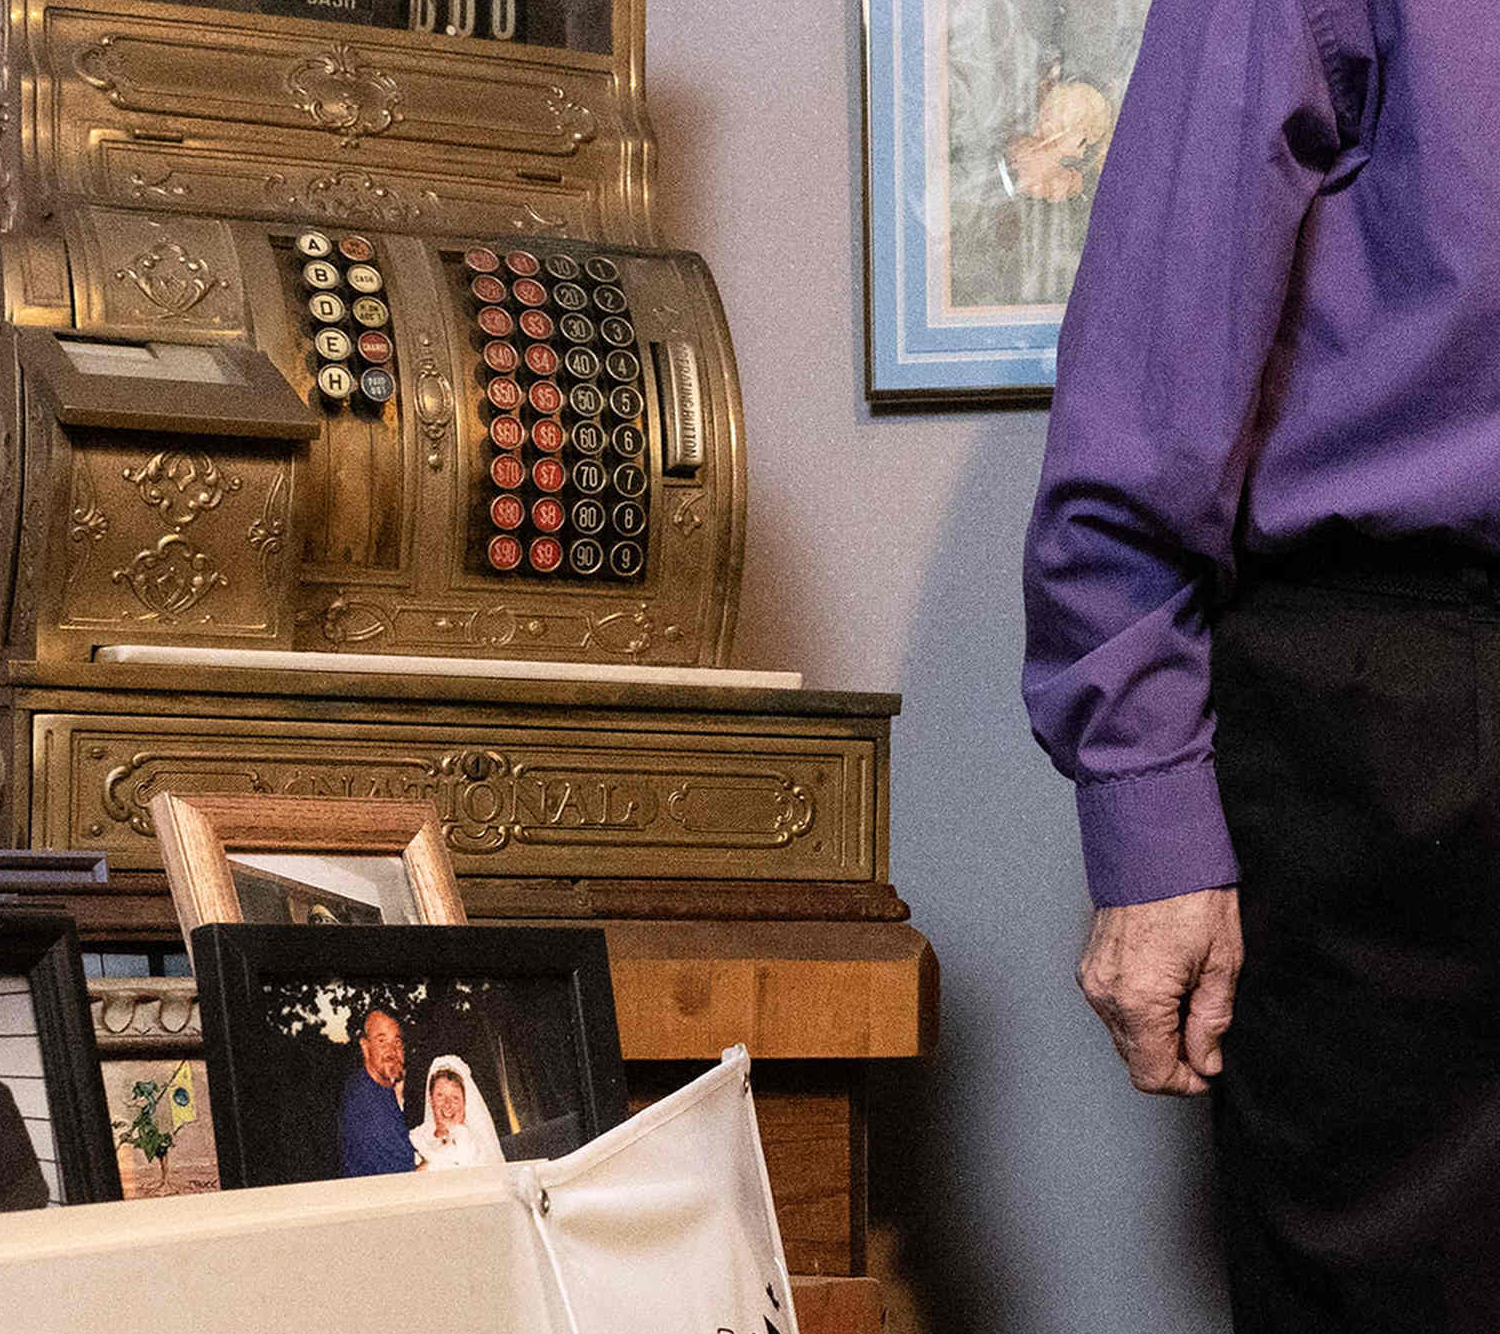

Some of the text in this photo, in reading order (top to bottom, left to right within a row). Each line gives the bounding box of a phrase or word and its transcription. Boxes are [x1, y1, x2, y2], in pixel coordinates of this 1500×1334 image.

[308, 238, 321, 251] A
[314, 268, 328, 282] B
[320, 301, 332, 315] D
[560, 289, 579, 306] 20
[604, 291, 614, 308] 2
[567, 319, 587, 338] 30
[611, 323, 623, 341] 3
[327, 336, 340, 353] E
[533, 350, 551, 370] $4
[572, 354, 590, 374] 40
[617, 358, 628, 376] 4
[329, 373, 342, 390] H
[493, 382, 516, 404] $50
[538, 388, 554, 409] $5
[577, 389, 595, 411] 50
[621, 392, 631, 413] 5
[540, 424, 557, 446] $6
[580, 427, 597, 448] 60
[624, 430, 634, 451] 6
[682, 409, 698, 459] BUTTON
[496, 460, 519, 482] $70
[540, 464, 556, 486] $7
[581, 465, 598, 487] 70
[626, 469, 634, 491] 7
[540, 504, 557, 525] $8
[579, 507, 597, 528] 80
[624, 507, 634, 529] 8
[536, 544, 553, 565] $9
[576, 545, 594, 566] 90
[621, 548, 631, 569] 9
